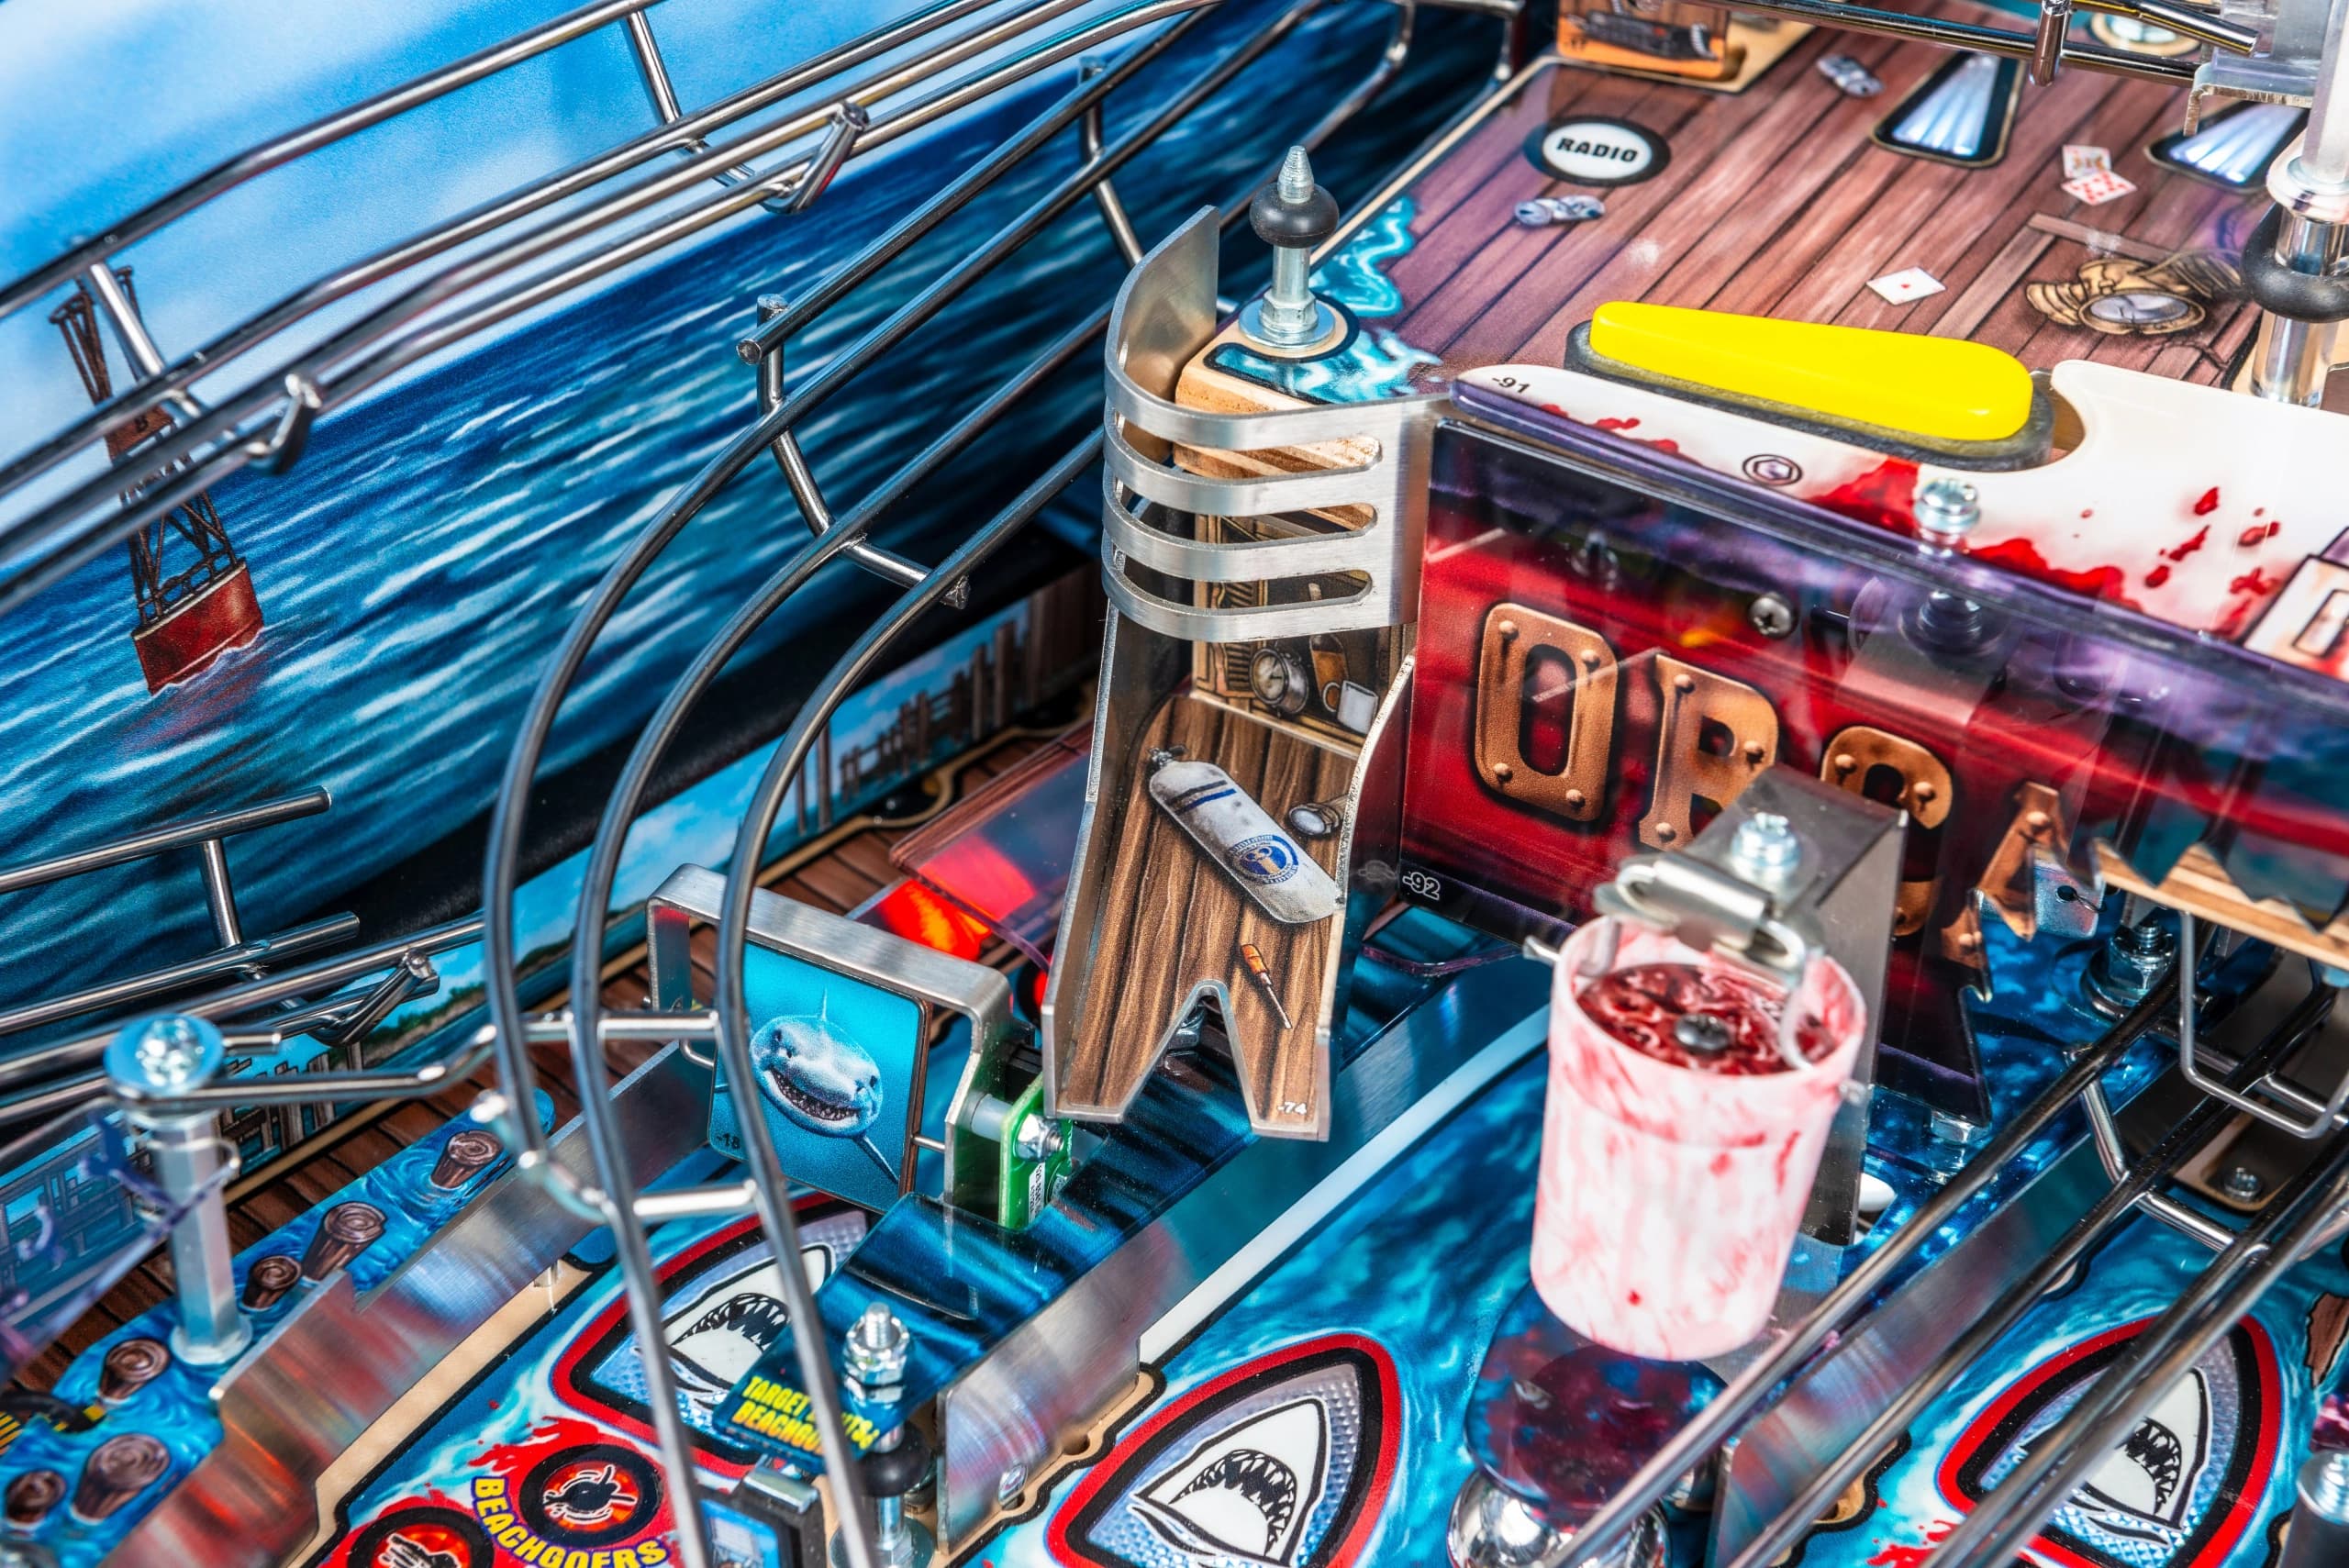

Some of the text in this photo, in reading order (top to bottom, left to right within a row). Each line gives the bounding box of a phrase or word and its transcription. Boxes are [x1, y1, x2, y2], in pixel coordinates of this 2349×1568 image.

[1555, 137, 1640, 162] RADIO
[1492, 377, 1531, 394] -91
[1402, 872, 1441, 900] -92
[1276, 1100, 1308, 1115] -74
[716, 1132, 741, 1150] -18
[741, 1375, 811, 1418] TARGET
[471, 1475, 670, 1568] BEACHGOERS
